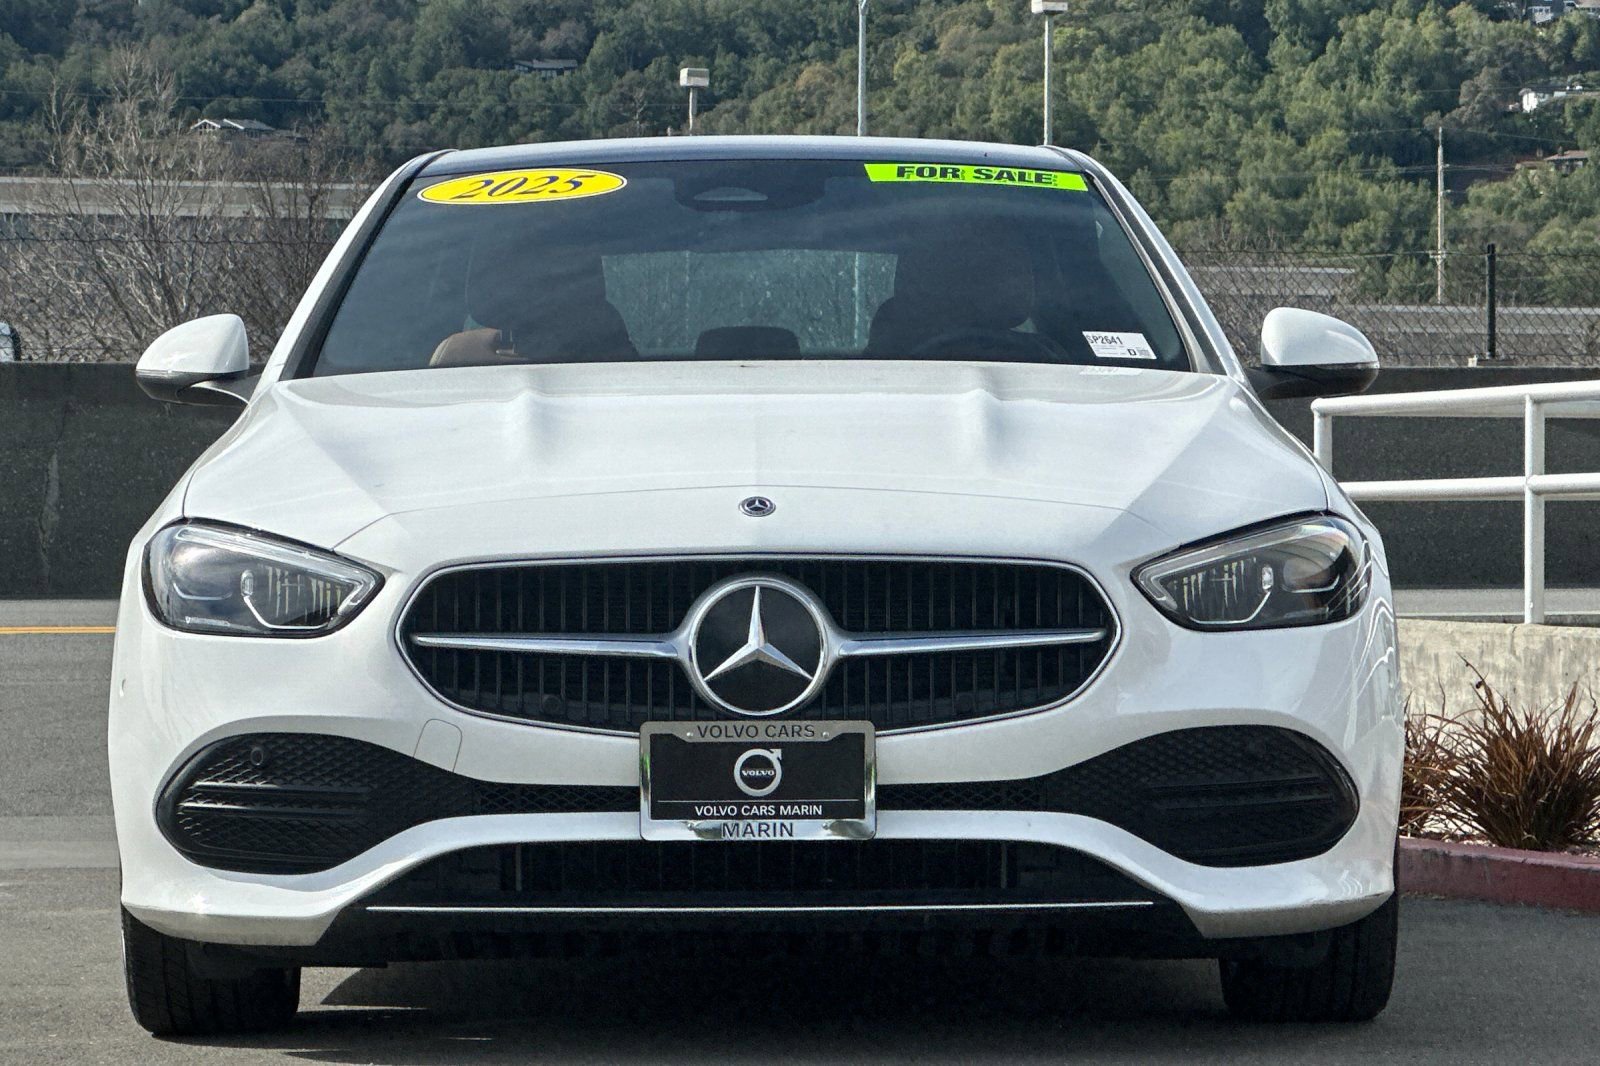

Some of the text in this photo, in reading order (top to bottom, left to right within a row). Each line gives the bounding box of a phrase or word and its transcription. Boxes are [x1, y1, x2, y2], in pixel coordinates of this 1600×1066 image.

[896, 165, 1055, 185] FOR SALE
[450, 174, 597, 200] 2025
[1085, 334, 1124, 345] SP2641
[697, 724, 816, 739] VOLVO CARS
[741, 769, 775, 777] VOLVO
[694, 805, 823, 817] VOLVO CARS MARIN
[721, 822, 794, 838] MARIN
